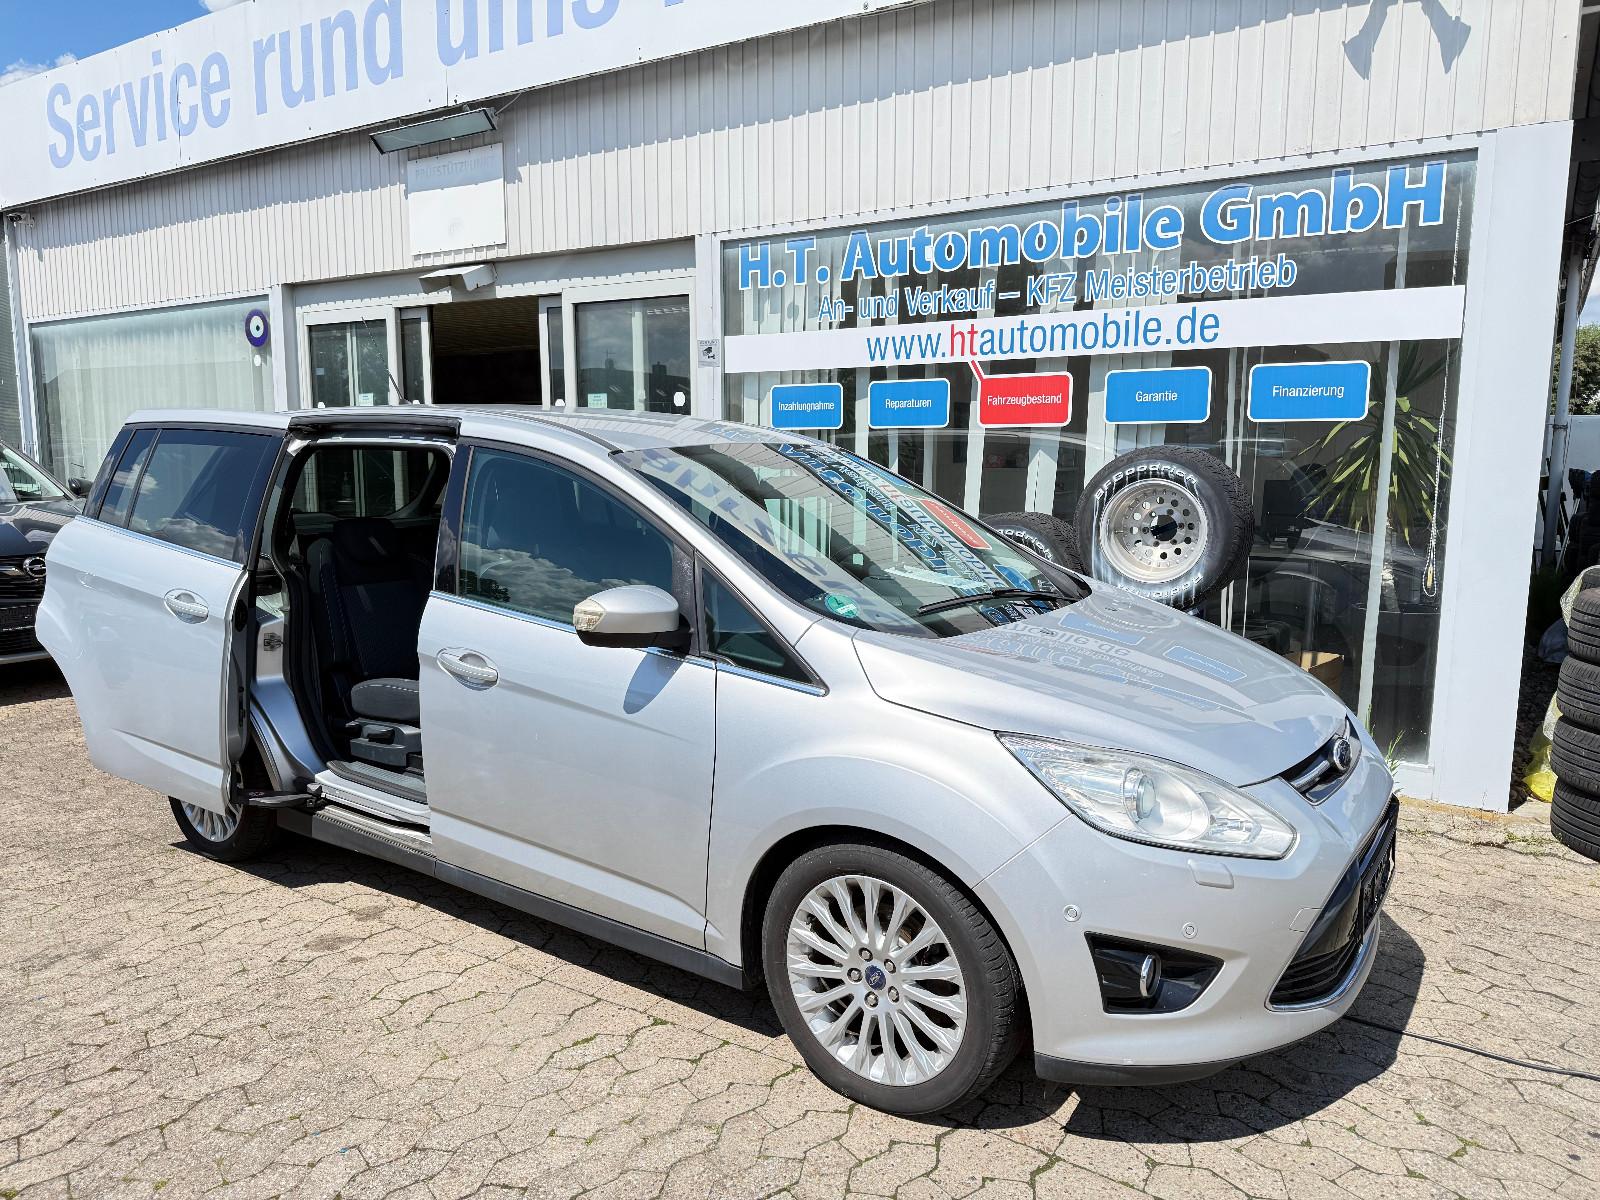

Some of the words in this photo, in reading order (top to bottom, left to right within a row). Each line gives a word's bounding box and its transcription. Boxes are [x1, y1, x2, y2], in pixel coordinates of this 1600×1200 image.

[46, 50, 231, 169] Service
[253, 0, 404, 116] rund
[738, 235, 832, 290] H.T.
[839, 192, 1185, 281] Automobile
[1200, 160, 1447, 244] GmbH
[818, 295, 853, 323] An-
[858, 288, 899, 319] und
[904, 279, 996, 317] Verkauf
[1027, 272, 1078, 306] KFZ
[1084, 252, 1298, 302] Meisterbetrieb
[866, 306, 1220, 362] www.htautomobile.de
[1136, 390, 1178, 402] Garantie
[1272, 385, 1345, 398] Finanzierung
[885, 398, 932, 410] Reparaturen
[987, 393, 1062, 406] Fahrzeugbestand
[778, 401, 834, 412] Inzahlungnahme
